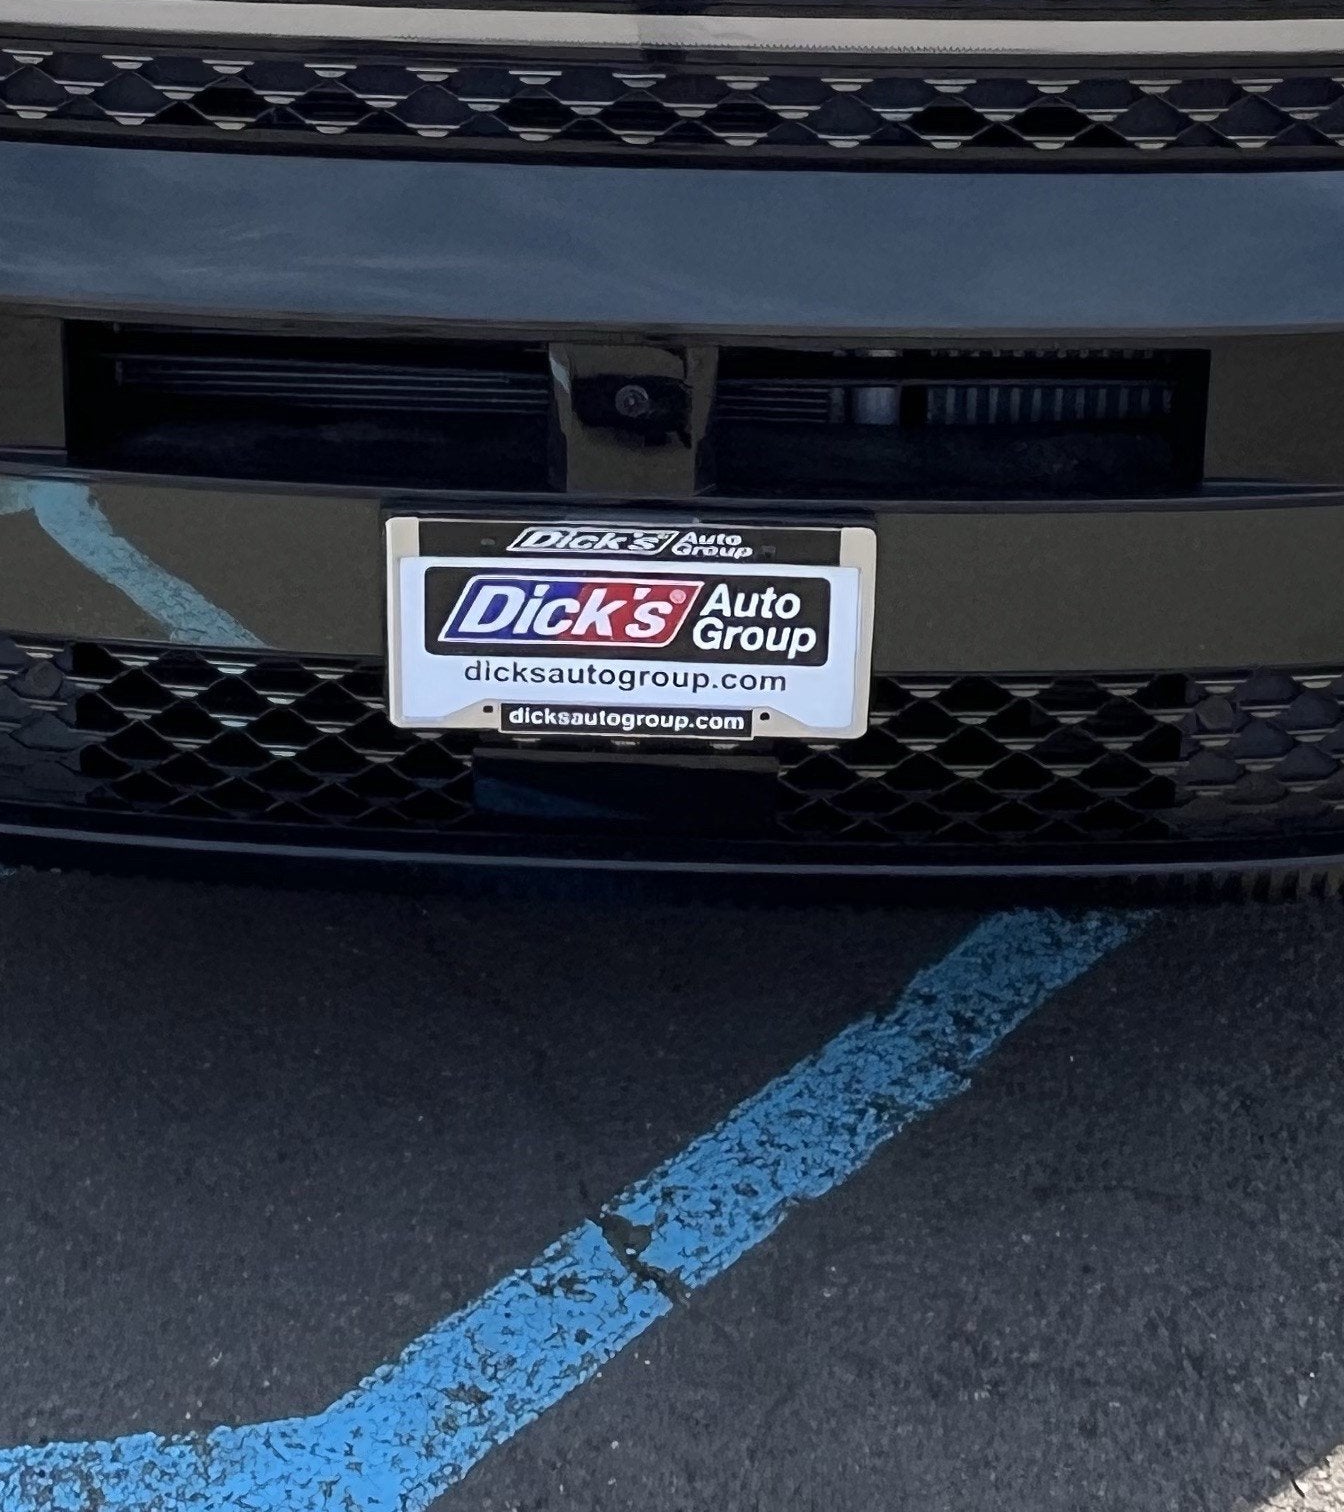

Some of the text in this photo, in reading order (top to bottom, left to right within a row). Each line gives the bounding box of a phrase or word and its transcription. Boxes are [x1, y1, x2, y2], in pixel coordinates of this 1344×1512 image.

[520, 530, 659, 552] Dick's
[670, 541, 754, 560] Group
[678, 531, 743, 547] Auto
[458, 584, 671, 639] Dick's
[699, 584, 801, 620] Auto
[692, 617, 818, 660] Group
[464, 659, 787, 693] dicksautogroup.com
[508, 708, 745, 732] dicksautogroup.com
